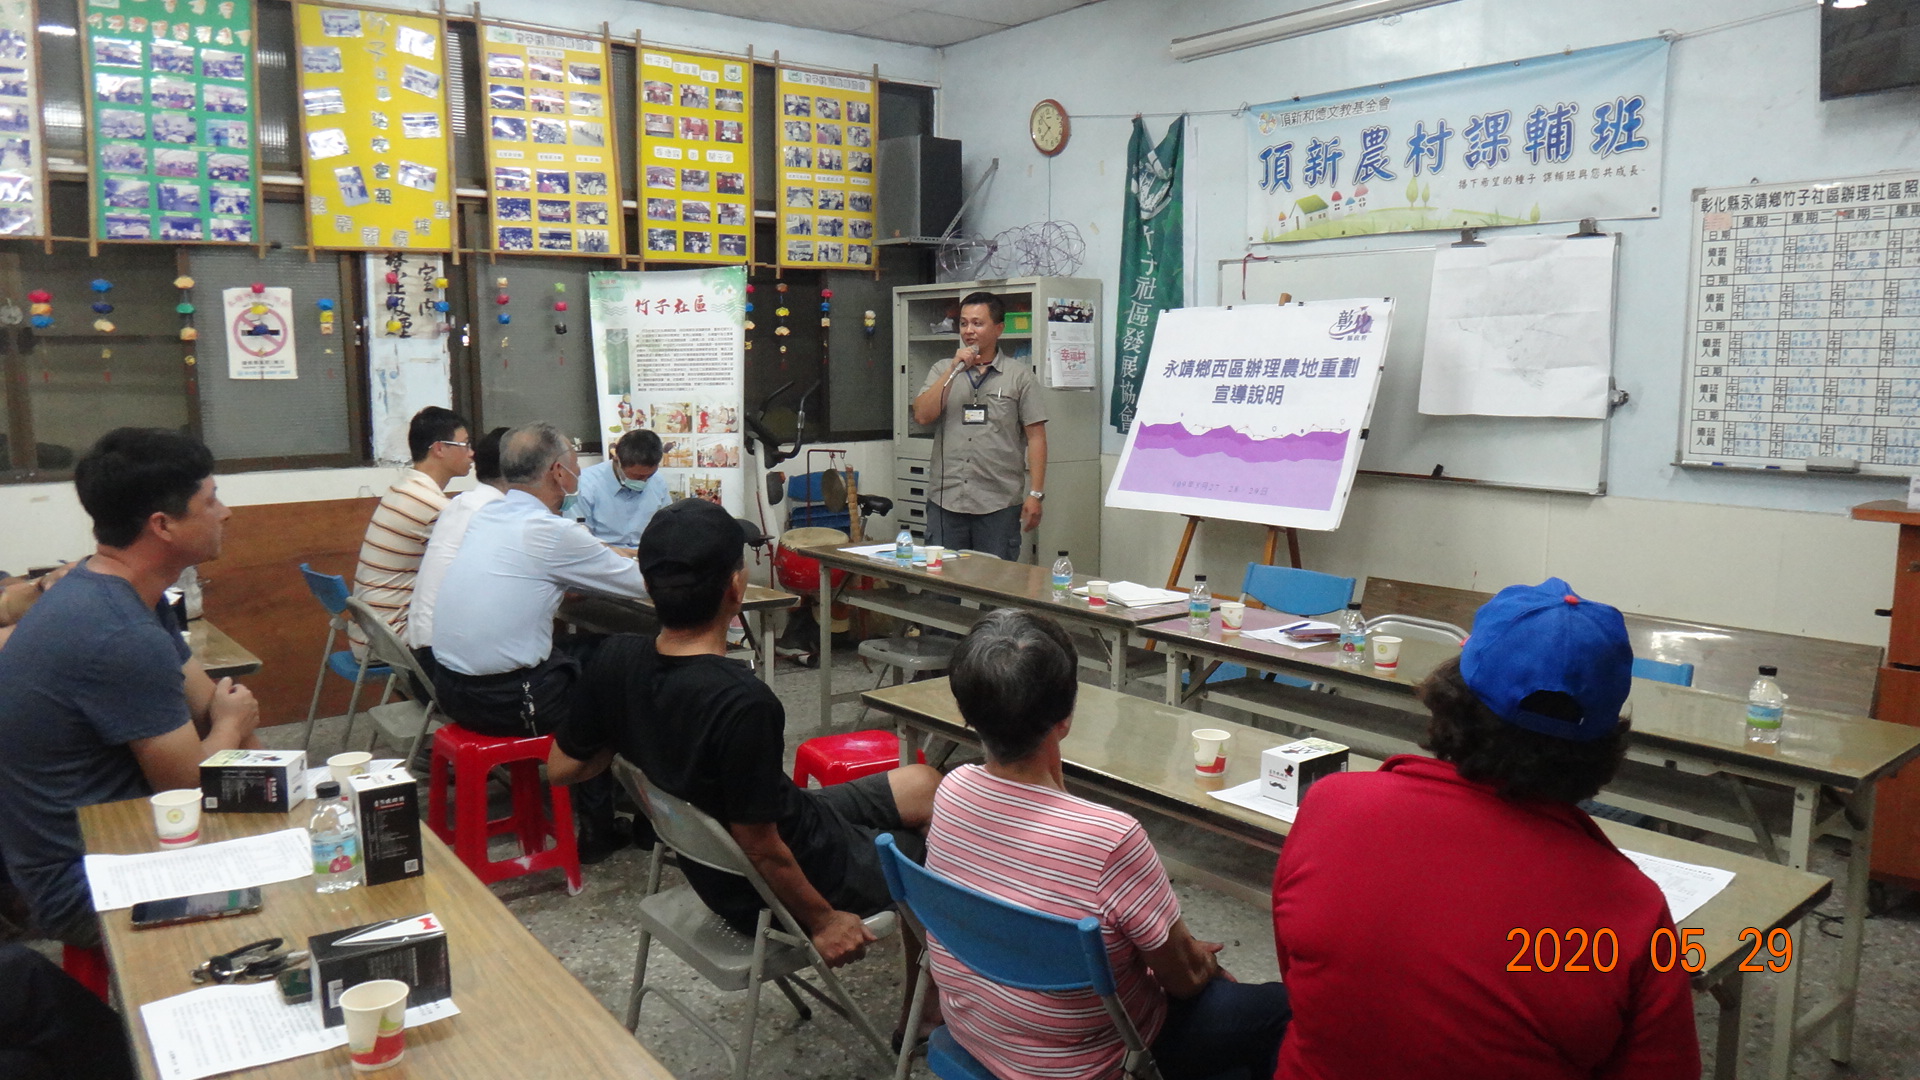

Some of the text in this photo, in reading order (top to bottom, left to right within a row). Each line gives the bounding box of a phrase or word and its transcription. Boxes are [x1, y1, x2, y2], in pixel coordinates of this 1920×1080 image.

[1280, 97, 1391, 127] 頂新和德文教基金會
[1259, 96, 1649, 194] 頂新農村課輔班
[1742, 214, 1782, 227] 星期一
[1792, 211, 1833, 224] 星期二
[1707, 257, 1726, 267] 人員
[635, 294, 707, 315] 竹子社區
[1705, 303, 1724, 313] 人員
[1701, 348, 1720, 358] 人員
[1163, 357, 1360, 378] 永靖鄉西區辦理農地重劃
[1212, 384, 1284, 405] 宣導說明
[1699, 393, 1718, 403] 人員
[1696, 437, 1715, 446] 人員
